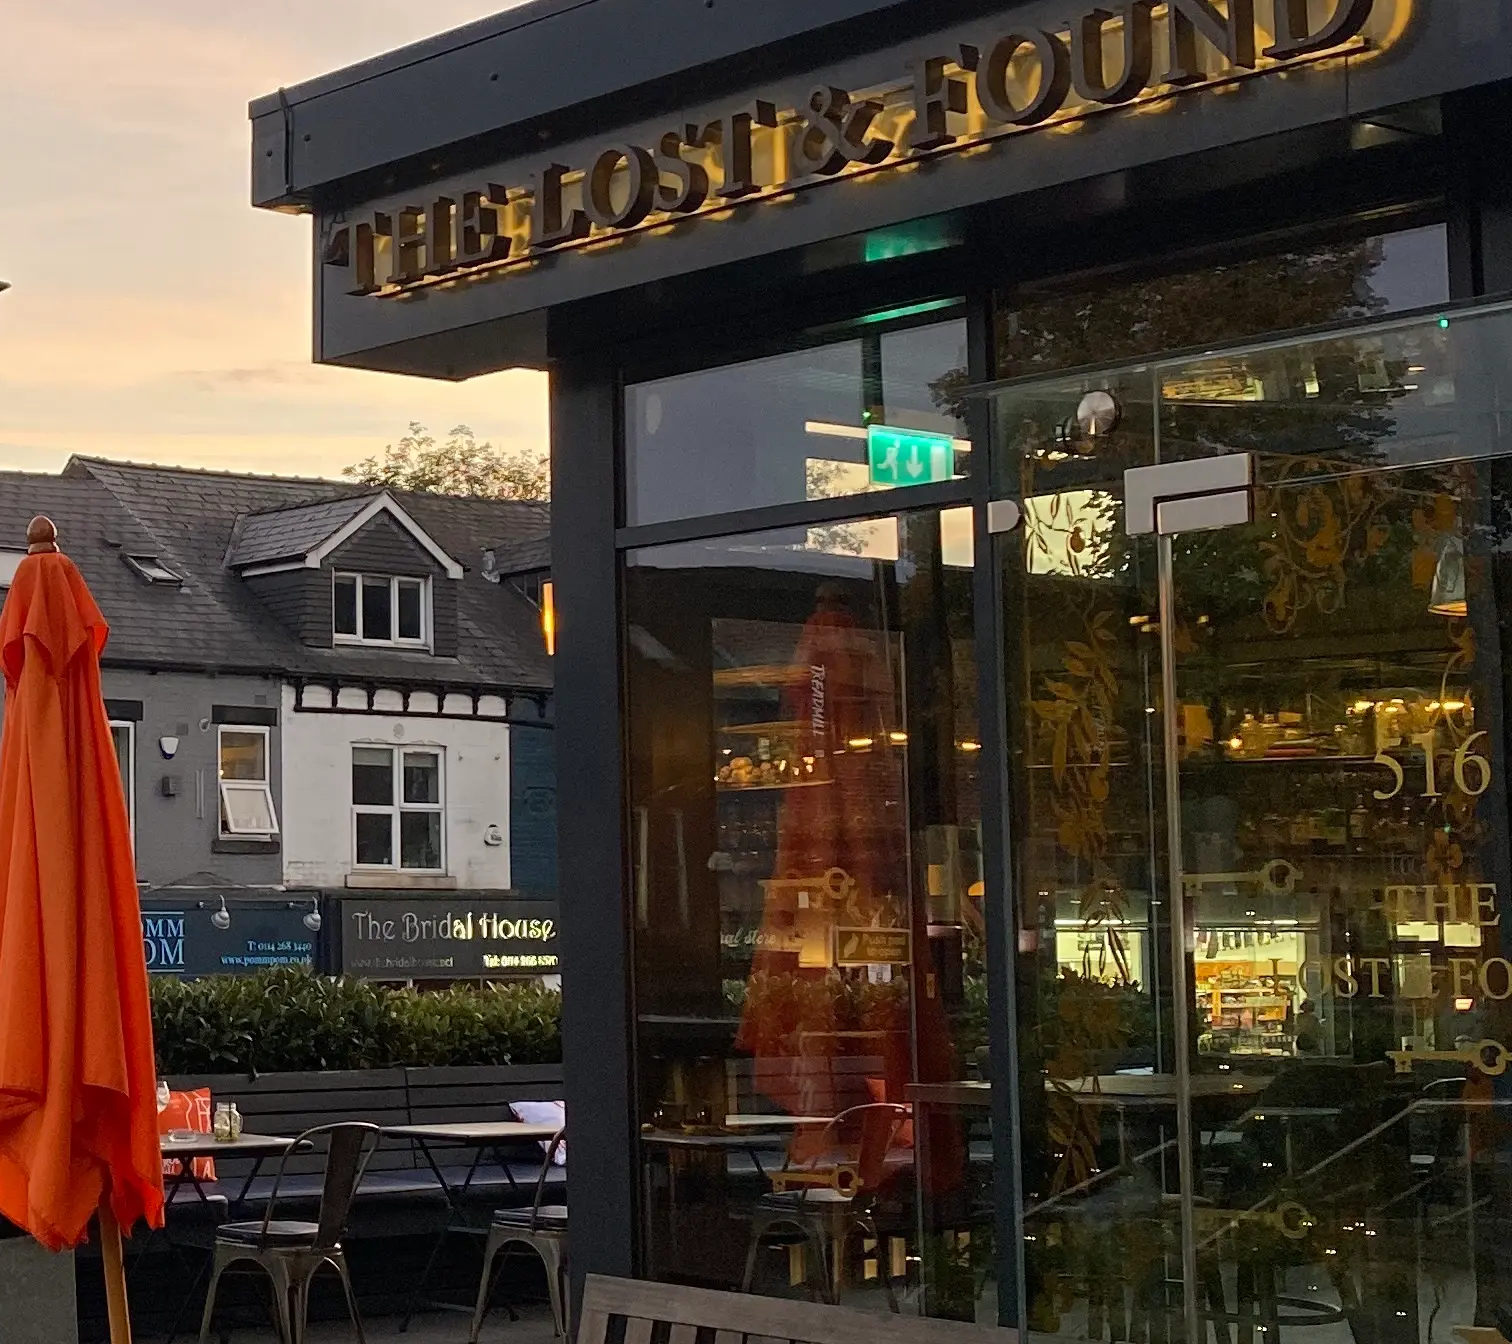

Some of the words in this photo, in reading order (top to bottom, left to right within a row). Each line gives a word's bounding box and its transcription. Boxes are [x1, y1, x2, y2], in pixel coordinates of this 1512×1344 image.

[322, 182, 513, 295] THE
[530, 100, 776, 247] LOST
[792, 86, 893, 175] &
[1373, 729, 1491, 800] 516
[352, 909, 396, 940] The
[402, 911, 473, 942] Bridal
[479, 912, 557, 942] House
[1385, 884, 1500, 926] THE
[139, 919, 185, 938] MM
